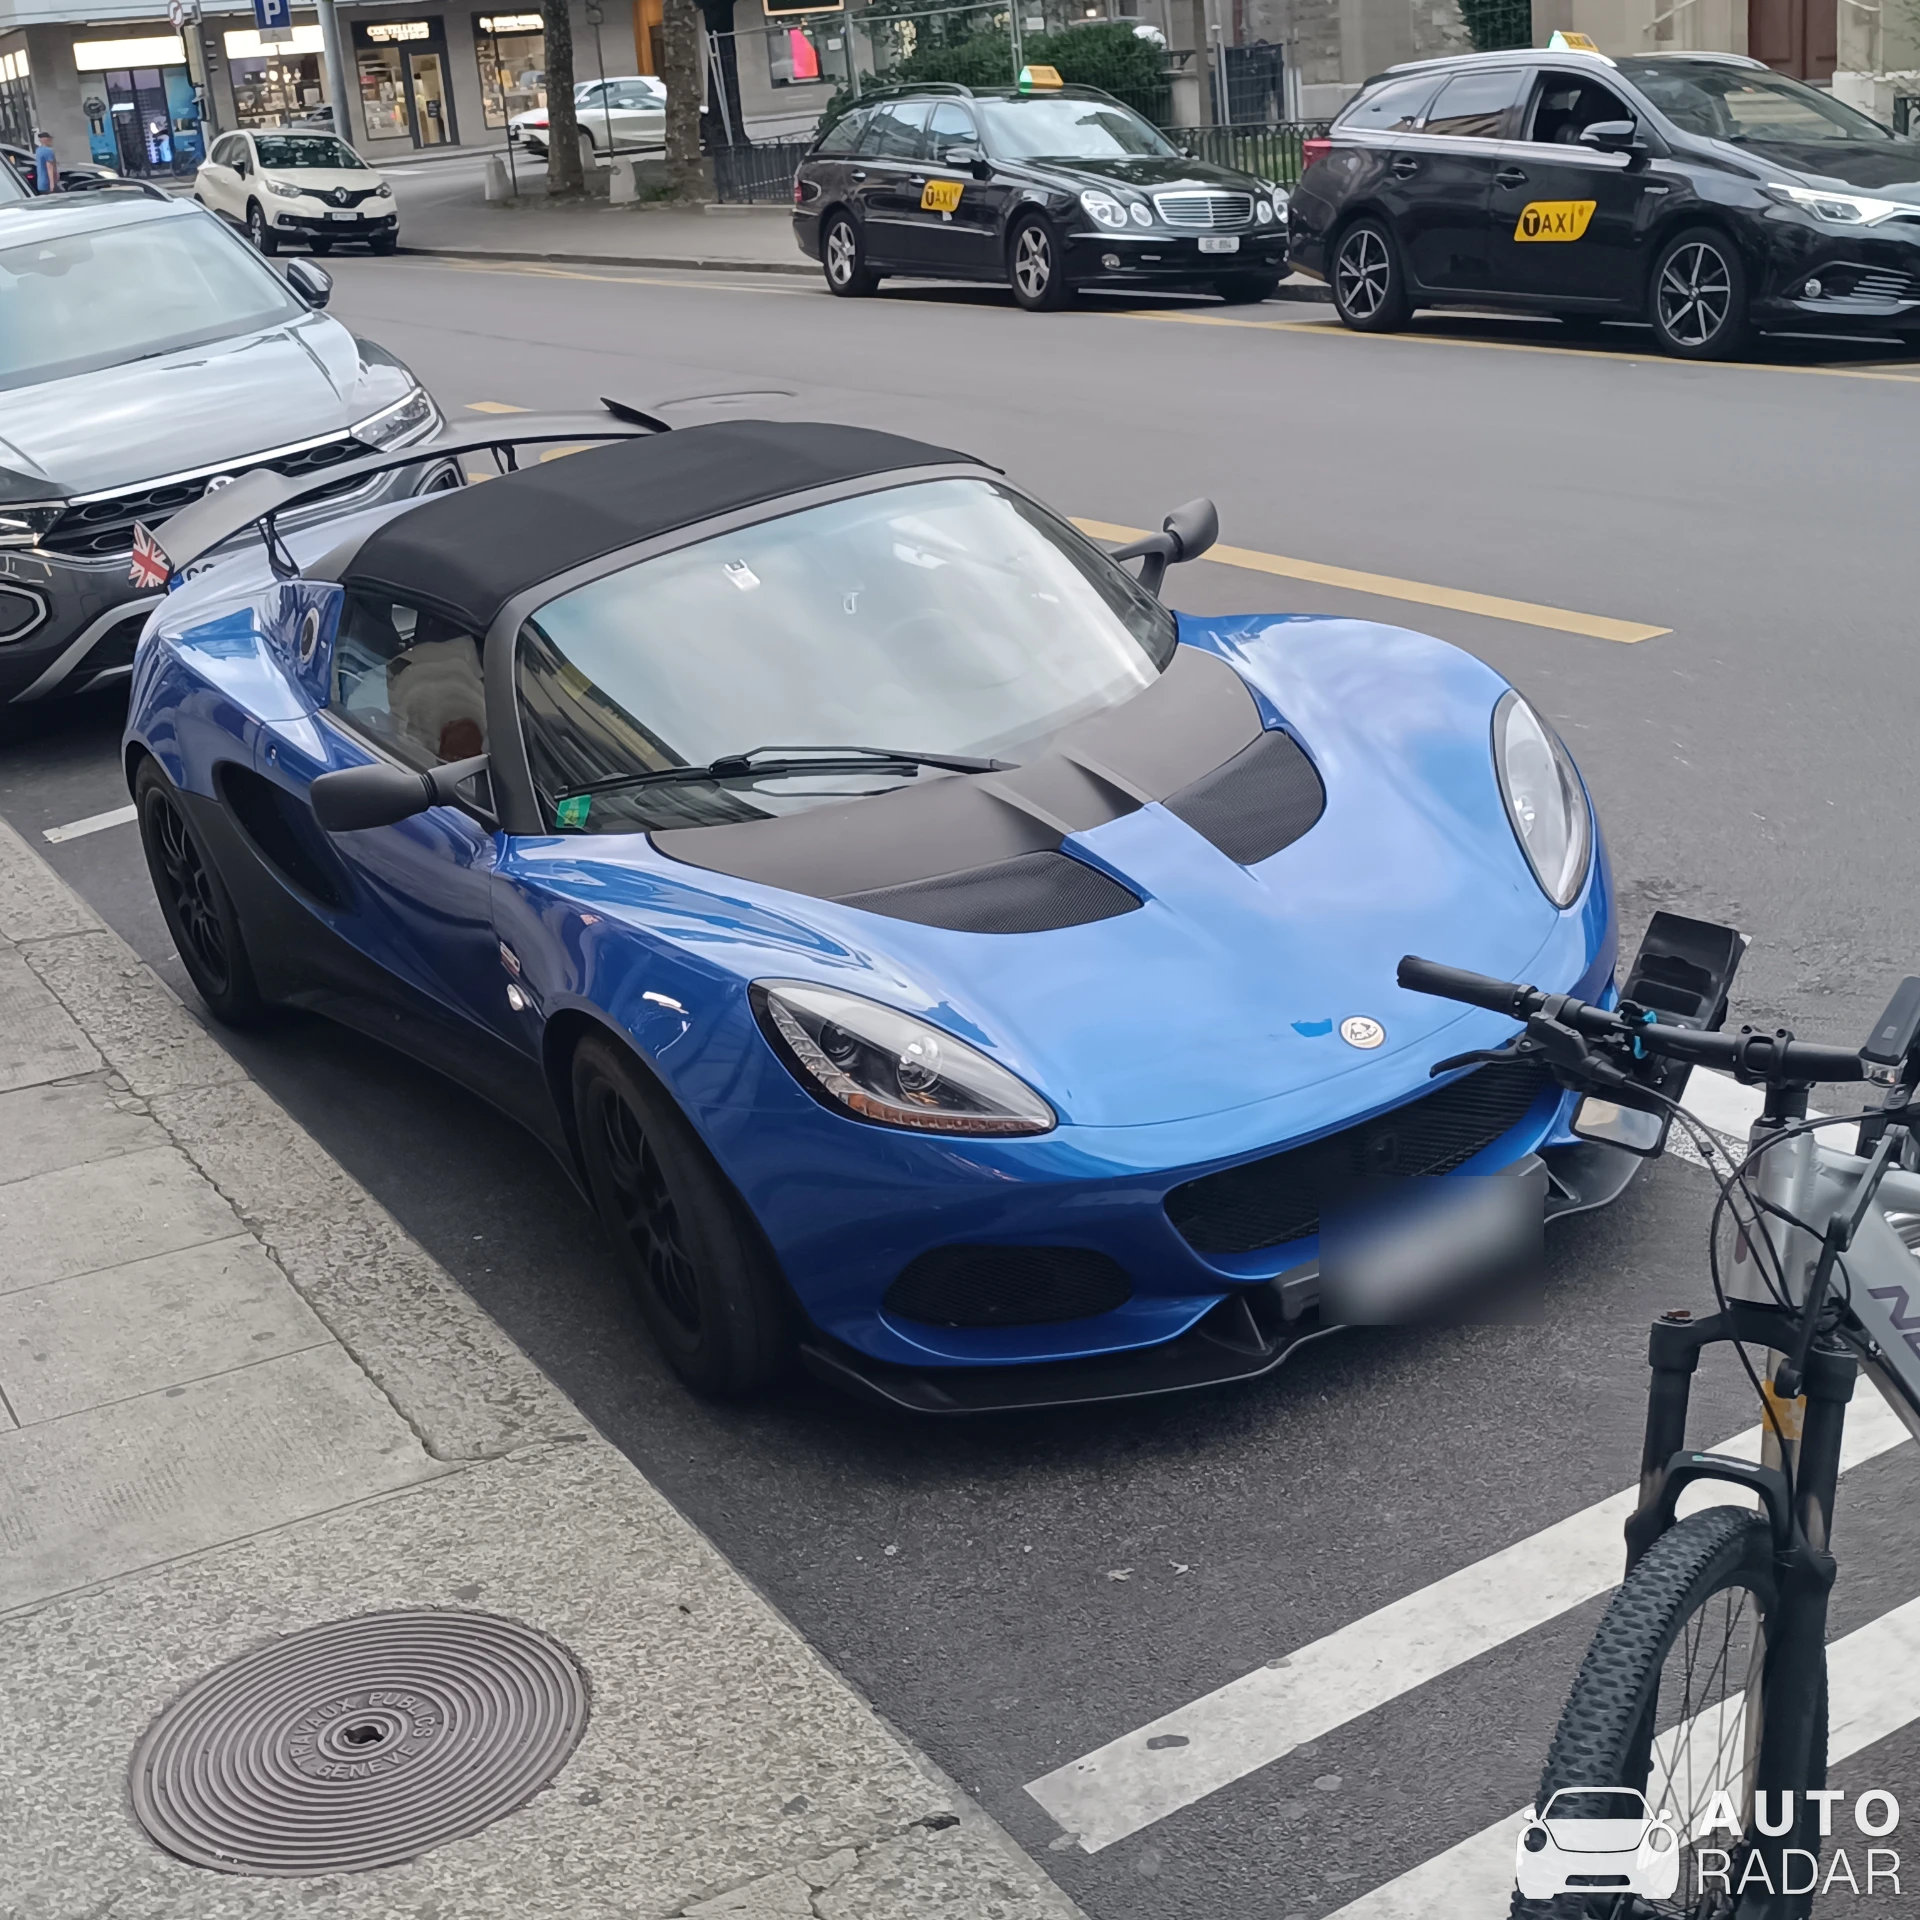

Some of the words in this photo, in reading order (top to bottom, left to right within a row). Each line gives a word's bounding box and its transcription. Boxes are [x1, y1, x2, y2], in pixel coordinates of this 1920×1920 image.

[263, 0, 280, 24] P
[926, 186, 953, 206] TAXI
[1523, 205, 1576, 236] TAXI
[290, 1698, 356, 1767] TRAVAUX
[369, 1692, 436, 1737] PUBLICS
[315, 1744, 419, 1779] GENEVE
